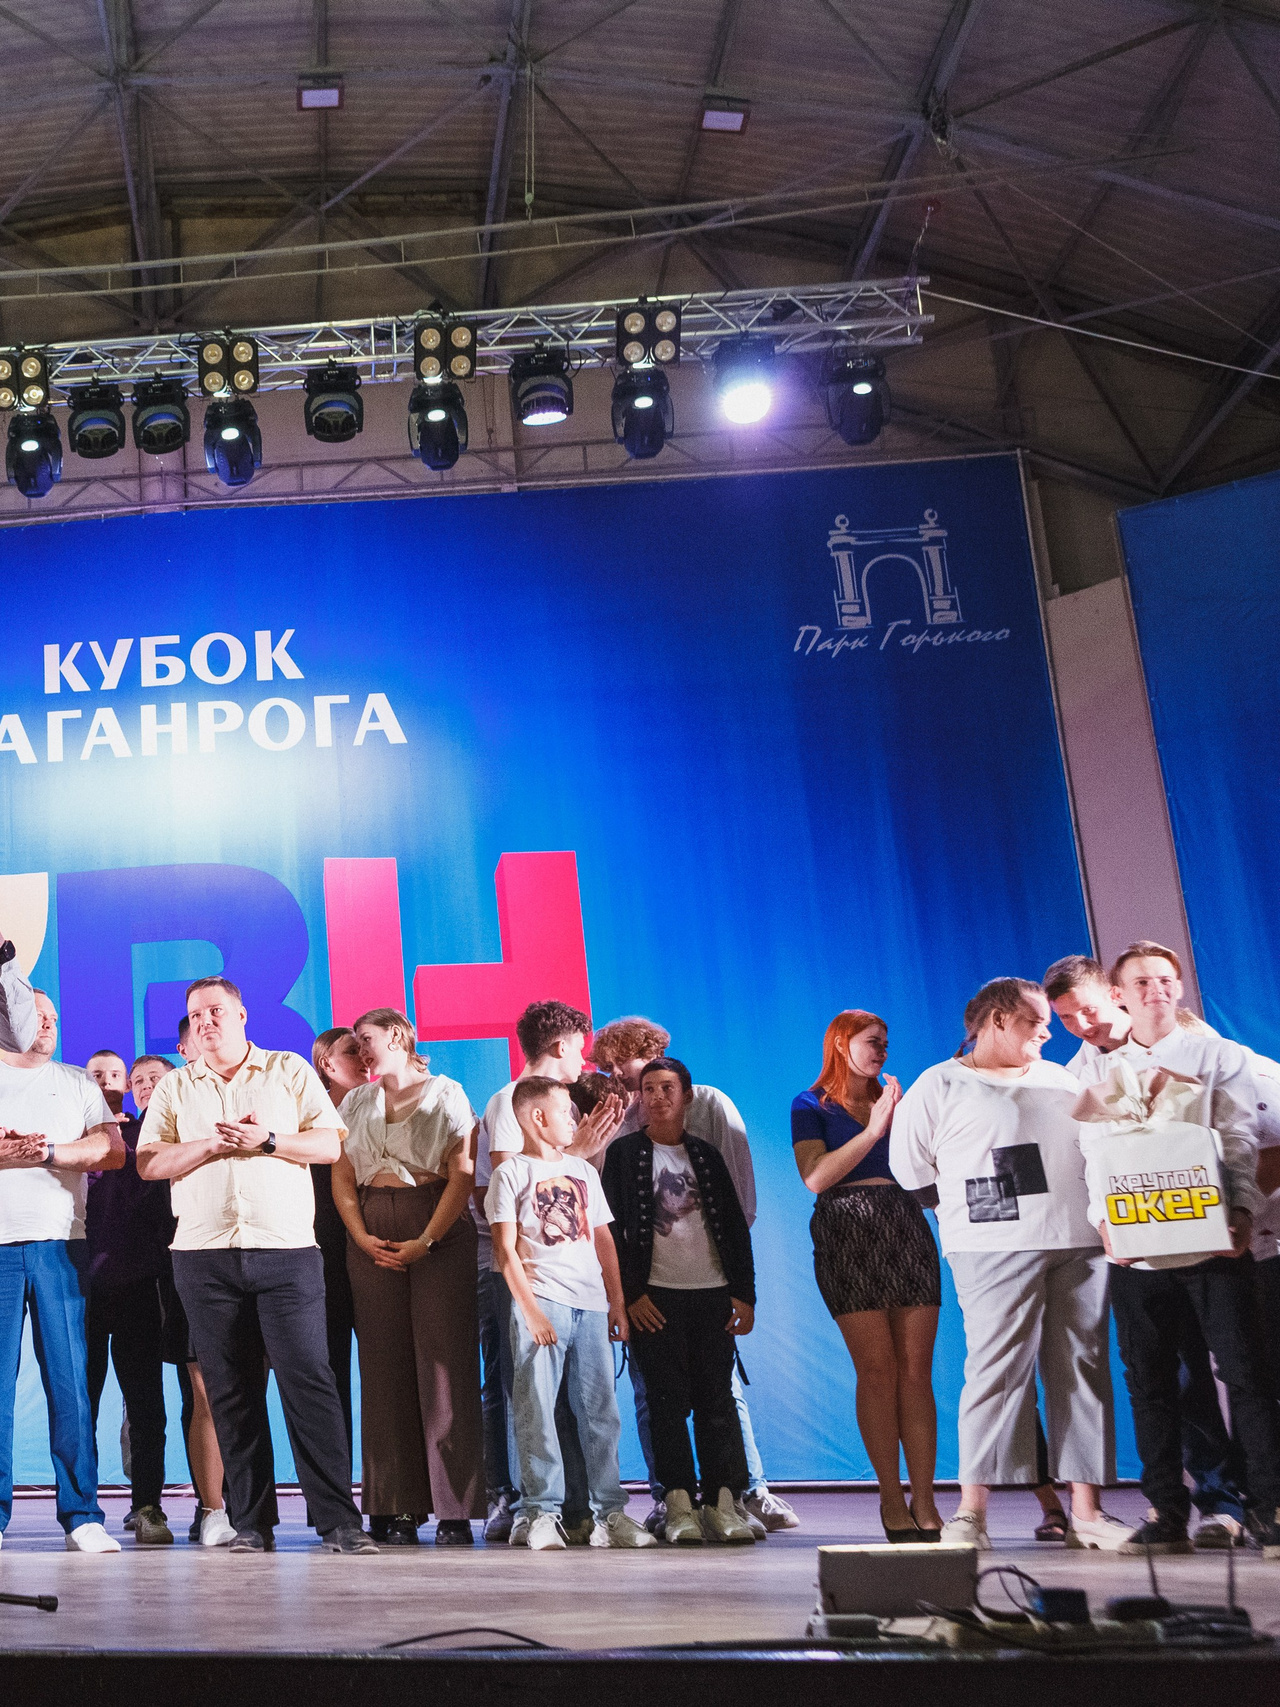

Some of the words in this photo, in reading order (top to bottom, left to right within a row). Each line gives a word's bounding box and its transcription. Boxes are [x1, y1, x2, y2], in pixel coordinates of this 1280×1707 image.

[793, 625, 869, 658] Парк
[879, 619, 1011, 653] Горького
[43, 629, 305, 694] КУБОК
[1109, 1165, 1209, 1193] КРУТОЙ
